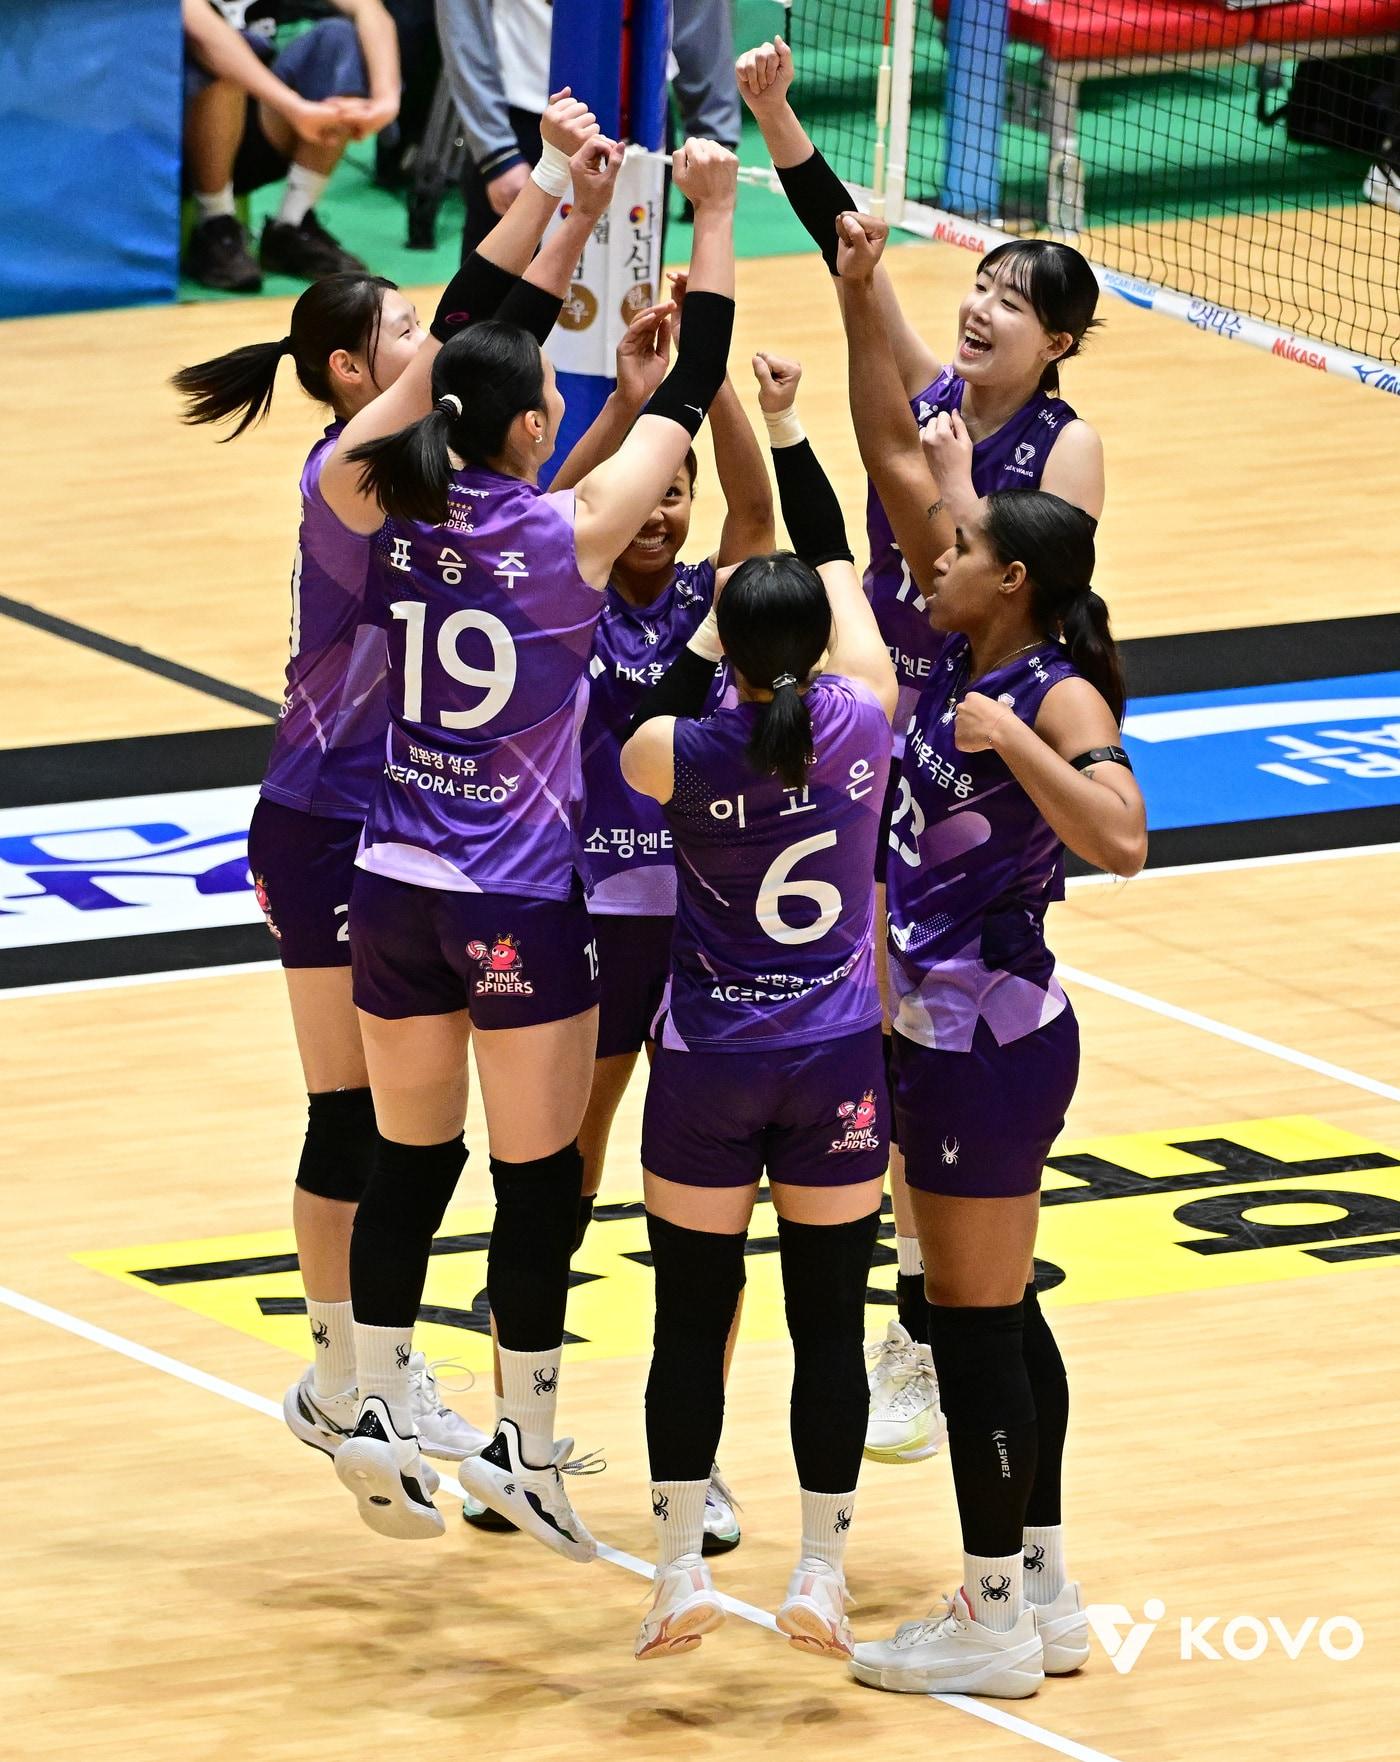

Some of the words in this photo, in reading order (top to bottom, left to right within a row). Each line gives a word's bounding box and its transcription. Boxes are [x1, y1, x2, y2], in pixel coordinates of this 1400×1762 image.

[932, 221, 985, 253] MiKASA
[1271, 336, 1328, 373] MiKASA
[389, 600, 517, 730] 19
[408, 745, 444, 770] 친환경
[447, 755, 478, 777] 섬유
[755, 829, 843, 945] 6
[476, 980, 534, 994] SPIDERS
[485, 971, 521, 983] PINK
[845, 1127, 873, 1142] PINK
